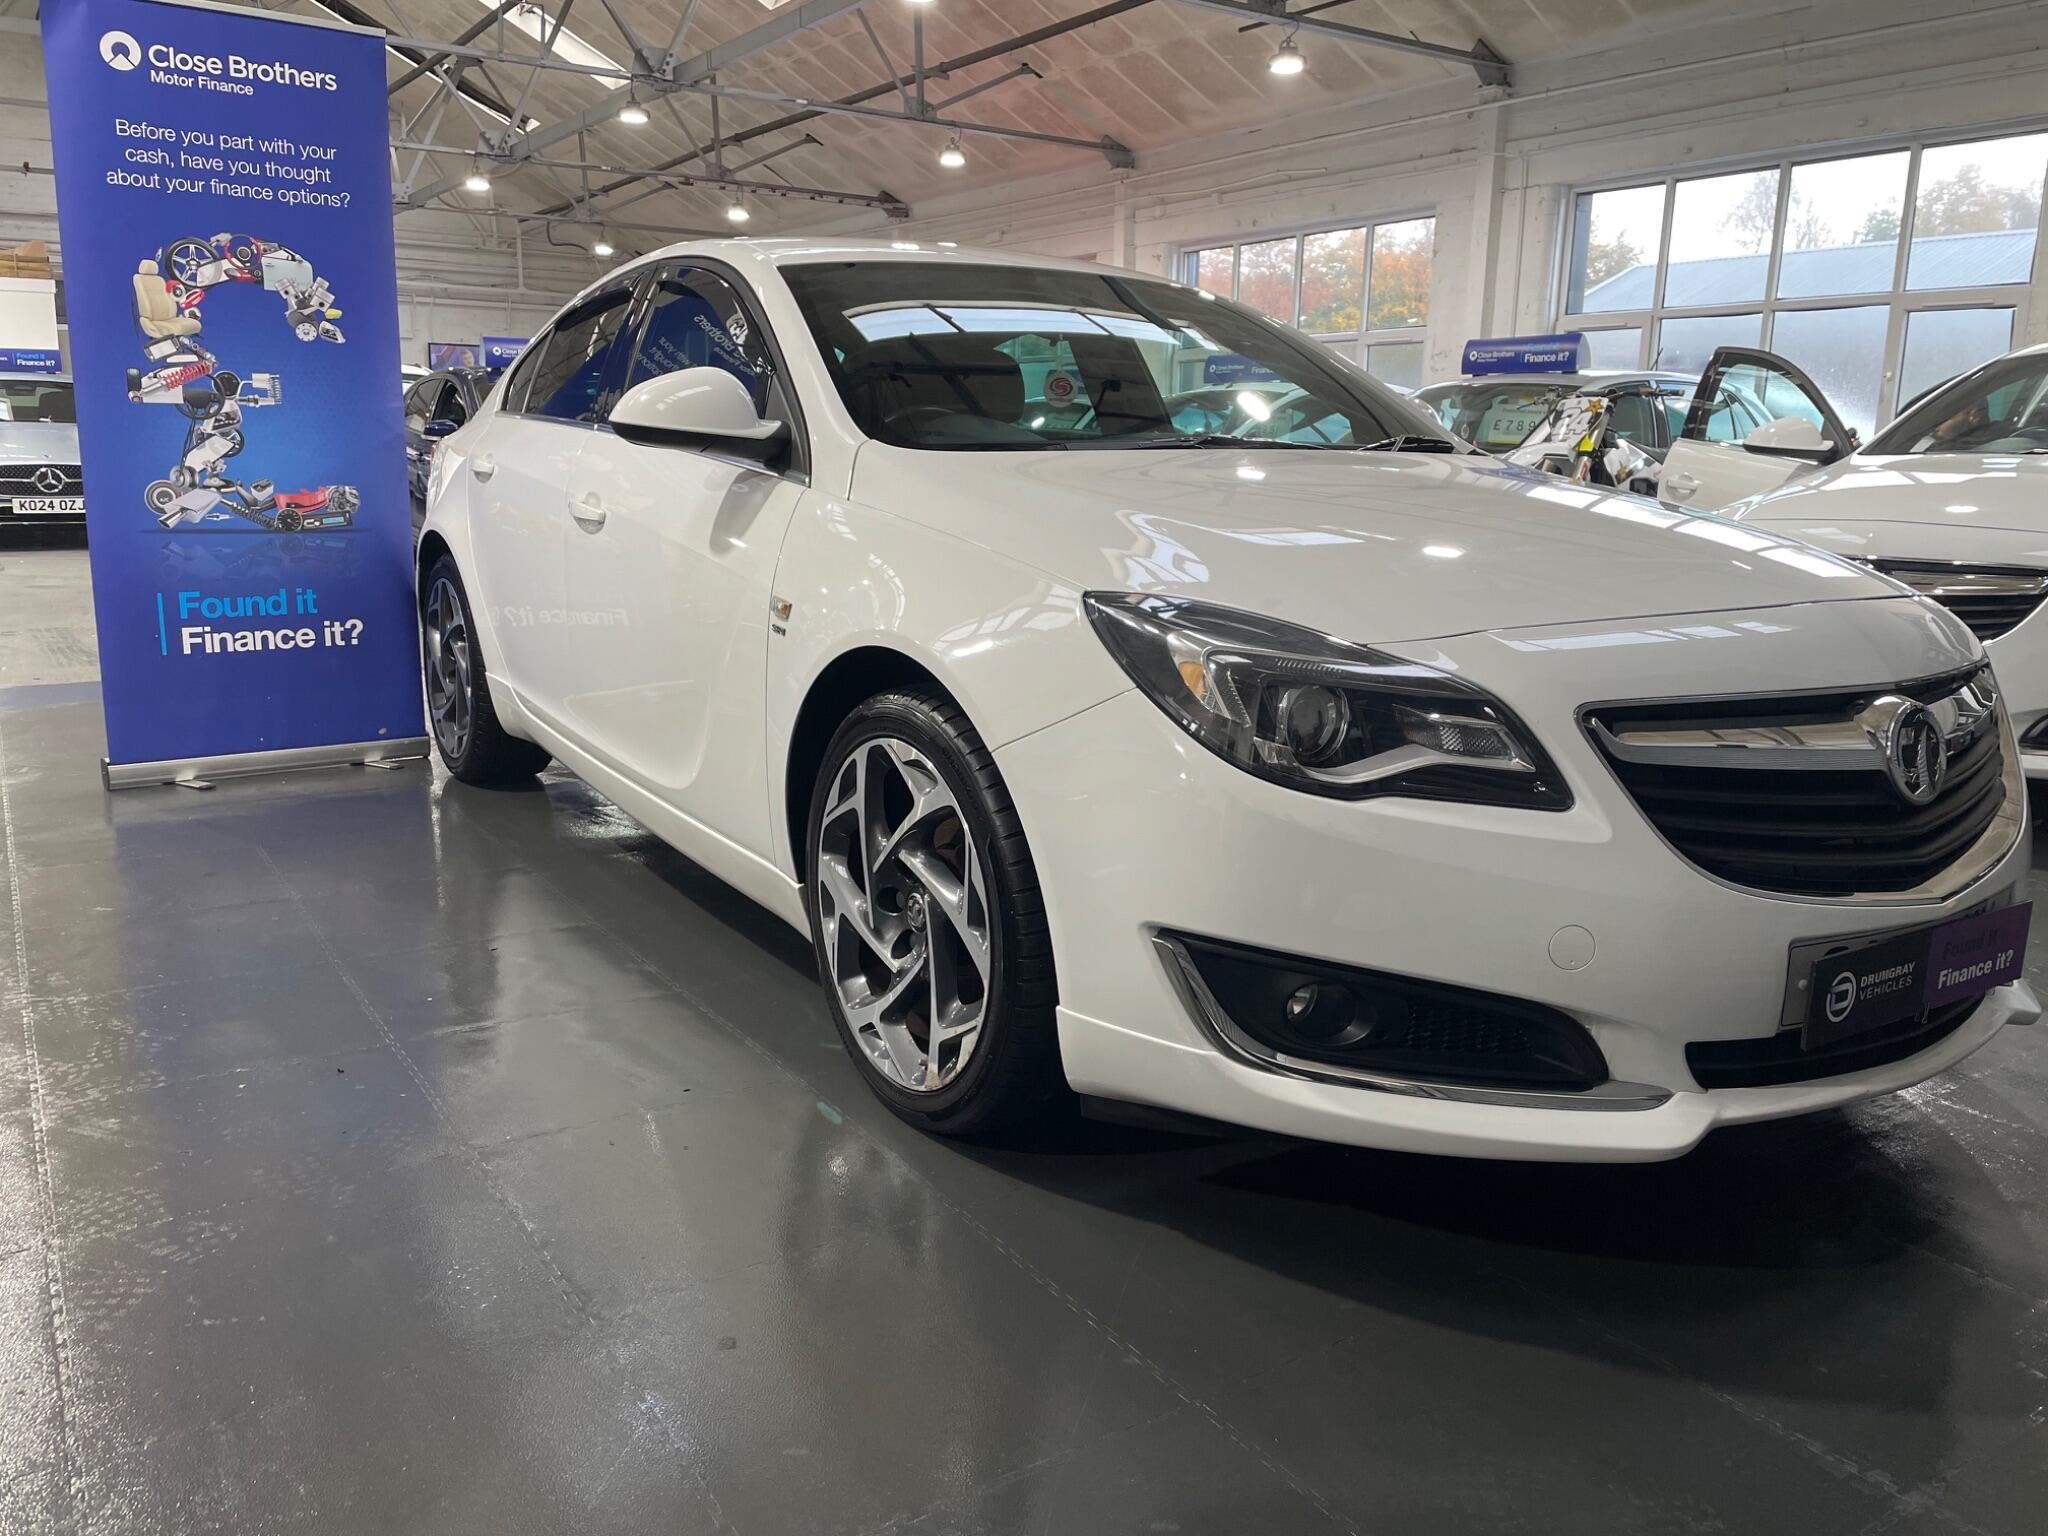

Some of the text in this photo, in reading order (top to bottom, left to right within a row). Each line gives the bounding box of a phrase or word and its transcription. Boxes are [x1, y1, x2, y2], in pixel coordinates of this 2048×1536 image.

[148, 44, 338, 91] Close Brothers
[150, 69, 254, 96] Motor Finance
[115, 118, 337, 161] Before you part with your
[125, 148, 332, 185] cash, have you thought
[106, 169, 351, 208] about your finance options?
[1524, 351, 1570, 363] Finance it?
[19, 499, 55, 511] KO24
[178, 587, 318, 619] Found it
[181, 618, 364, 655] Finance it?
[1860, 961, 1916, 988] DRUMGRAY
[1938, 949, 2014, 990] Finance it?
[1859, 975, 1913, 1001] VEHICLES
